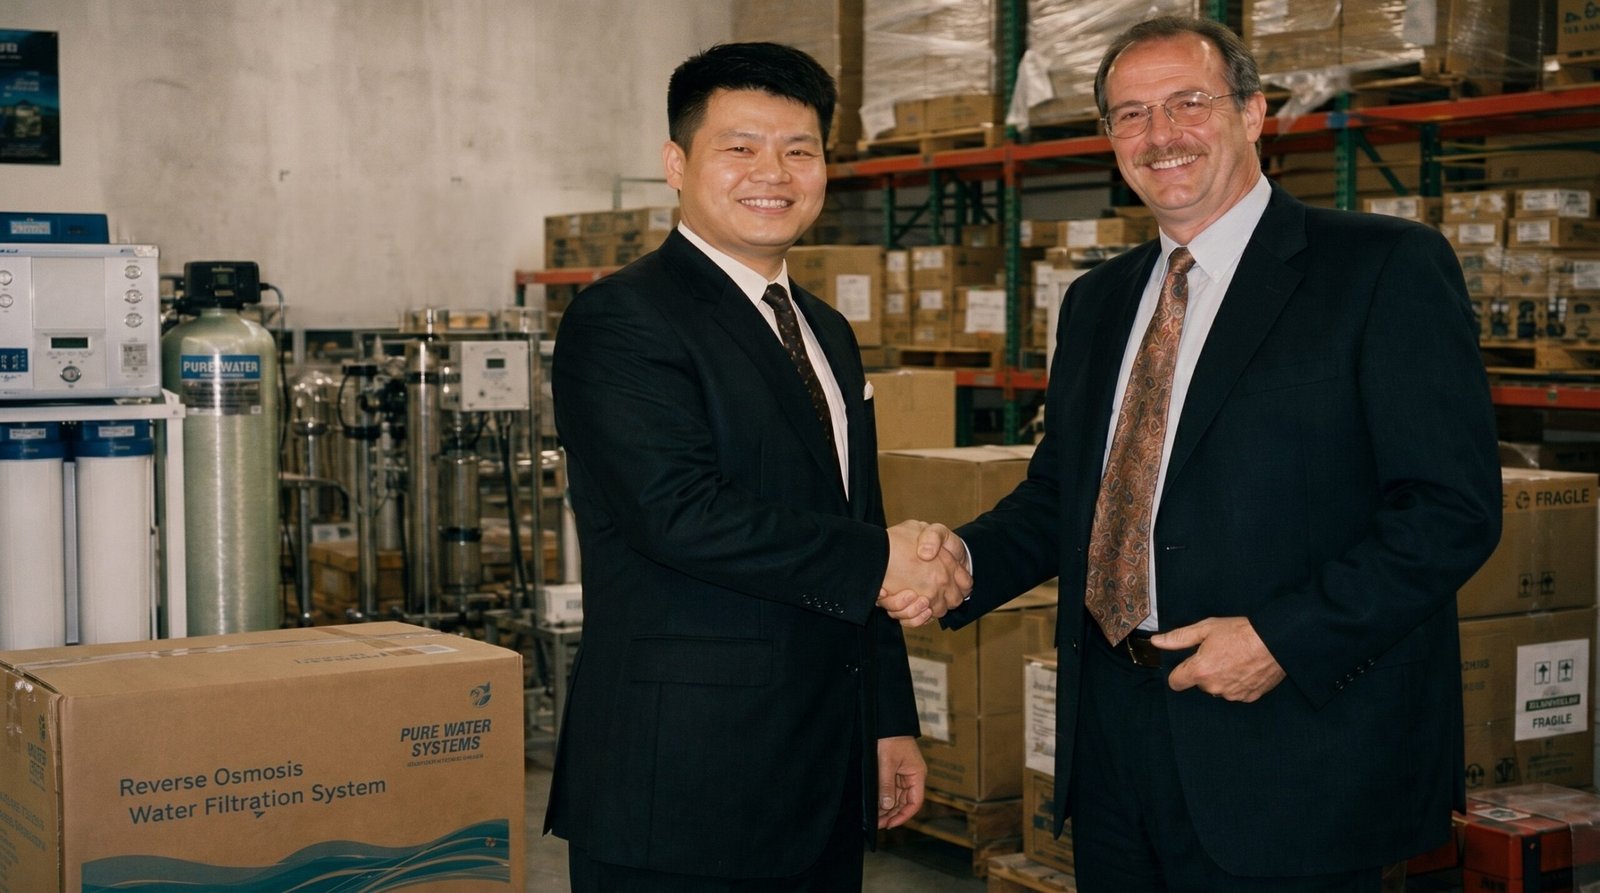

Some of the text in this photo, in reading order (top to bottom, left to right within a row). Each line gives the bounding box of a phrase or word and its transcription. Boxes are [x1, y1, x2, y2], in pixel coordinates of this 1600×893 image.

[183, 360, 258, 373] PURE WATER
[1535, 488, 1590, 506] FRAGLE
[400, 719, 491, 743] PURE WATER
[1532, 713, 1573, 729] FRAGILE
[411, 736, 481, 758] SYSTEMS
[119, 760, 304, 797] Reverse Osmosis
[129, 778, 387, 825] Water Filtration System
